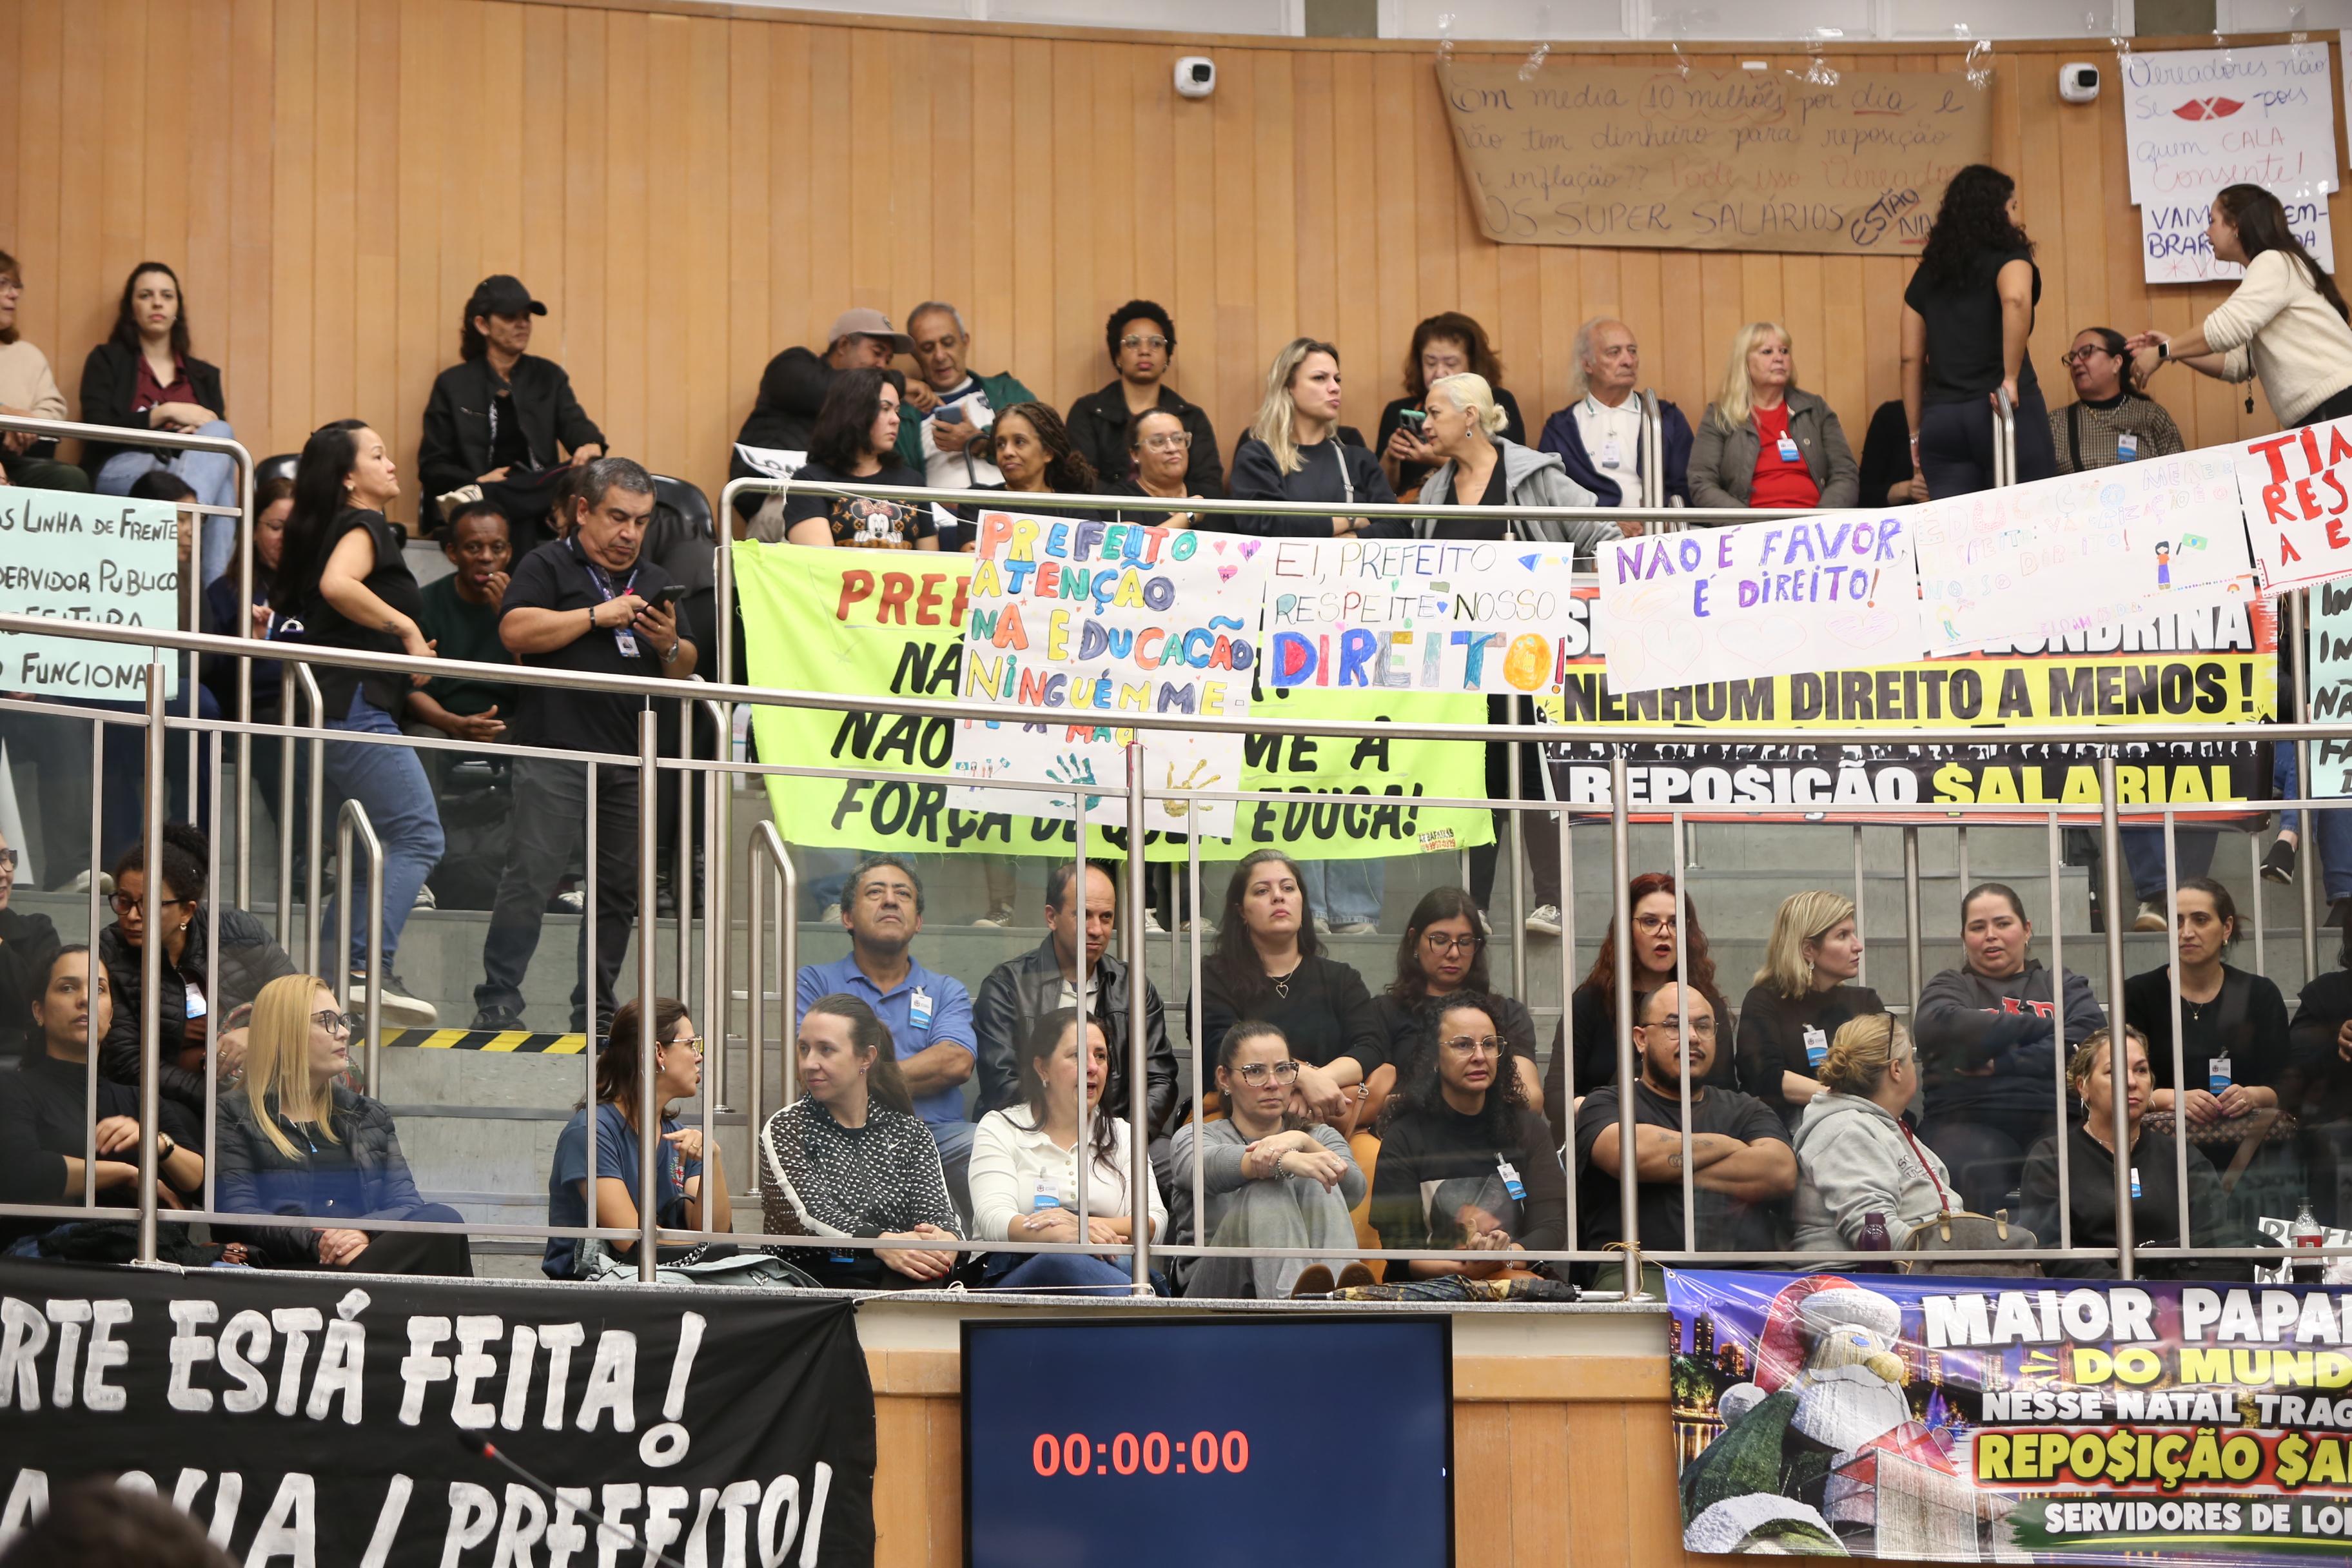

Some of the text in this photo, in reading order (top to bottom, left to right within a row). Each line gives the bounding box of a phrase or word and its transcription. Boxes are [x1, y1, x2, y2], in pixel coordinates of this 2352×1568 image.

[1794, 92, 1842, 126] por
[1851, 82, 1917, 112] dia
[2222, 126, 2286, 152] CALA
[1554, 201, 1673, 237] SUPER
[1692, 194, 1844, 236] SALÁRIOS
[92, 518, 115, 535] DE
[979, 513, 1199, 562] PREFEITO
[0, 566, 90, 593] ERVIDOR
[1616, 534, 1702, 585] NÃO
[1718, 525, 1741, 569] É
[972, 558, 1176, 615] ATENÇÃO
[1275, 589, 1556, 625] RESPEITE NOSSO
[1693, 565, 1880, 618] É DIREITO!
[971, 602, 1029, 651] NA
[1271, 627, 1565, 694] DIREITO!
[1563, 673, 1775, 721] NENHUM
[1790, 668, 1983, 721] DIREITO
[1997, 667, 2034, 718] A
[1251, 781, 1423, 842] EDUCA!
[1921, 1288, 2157, 1349] MAIOR
[167, 1288, 372, 1425] ESTÁ
[2073, 1348, 2352, 1389] DO MUND
[1982, 1391, 2104, 1422] NESSE
[2116, 1391, 2243, 1422] NATAL
[1032, 1430, 1250, 1476] 00:00:00
[2275, 1433, 2352, 1486] $A
[2044, 1501, 2242, 1534] SERVIDORES
[2251, 1503, 2291, 1533] DE
